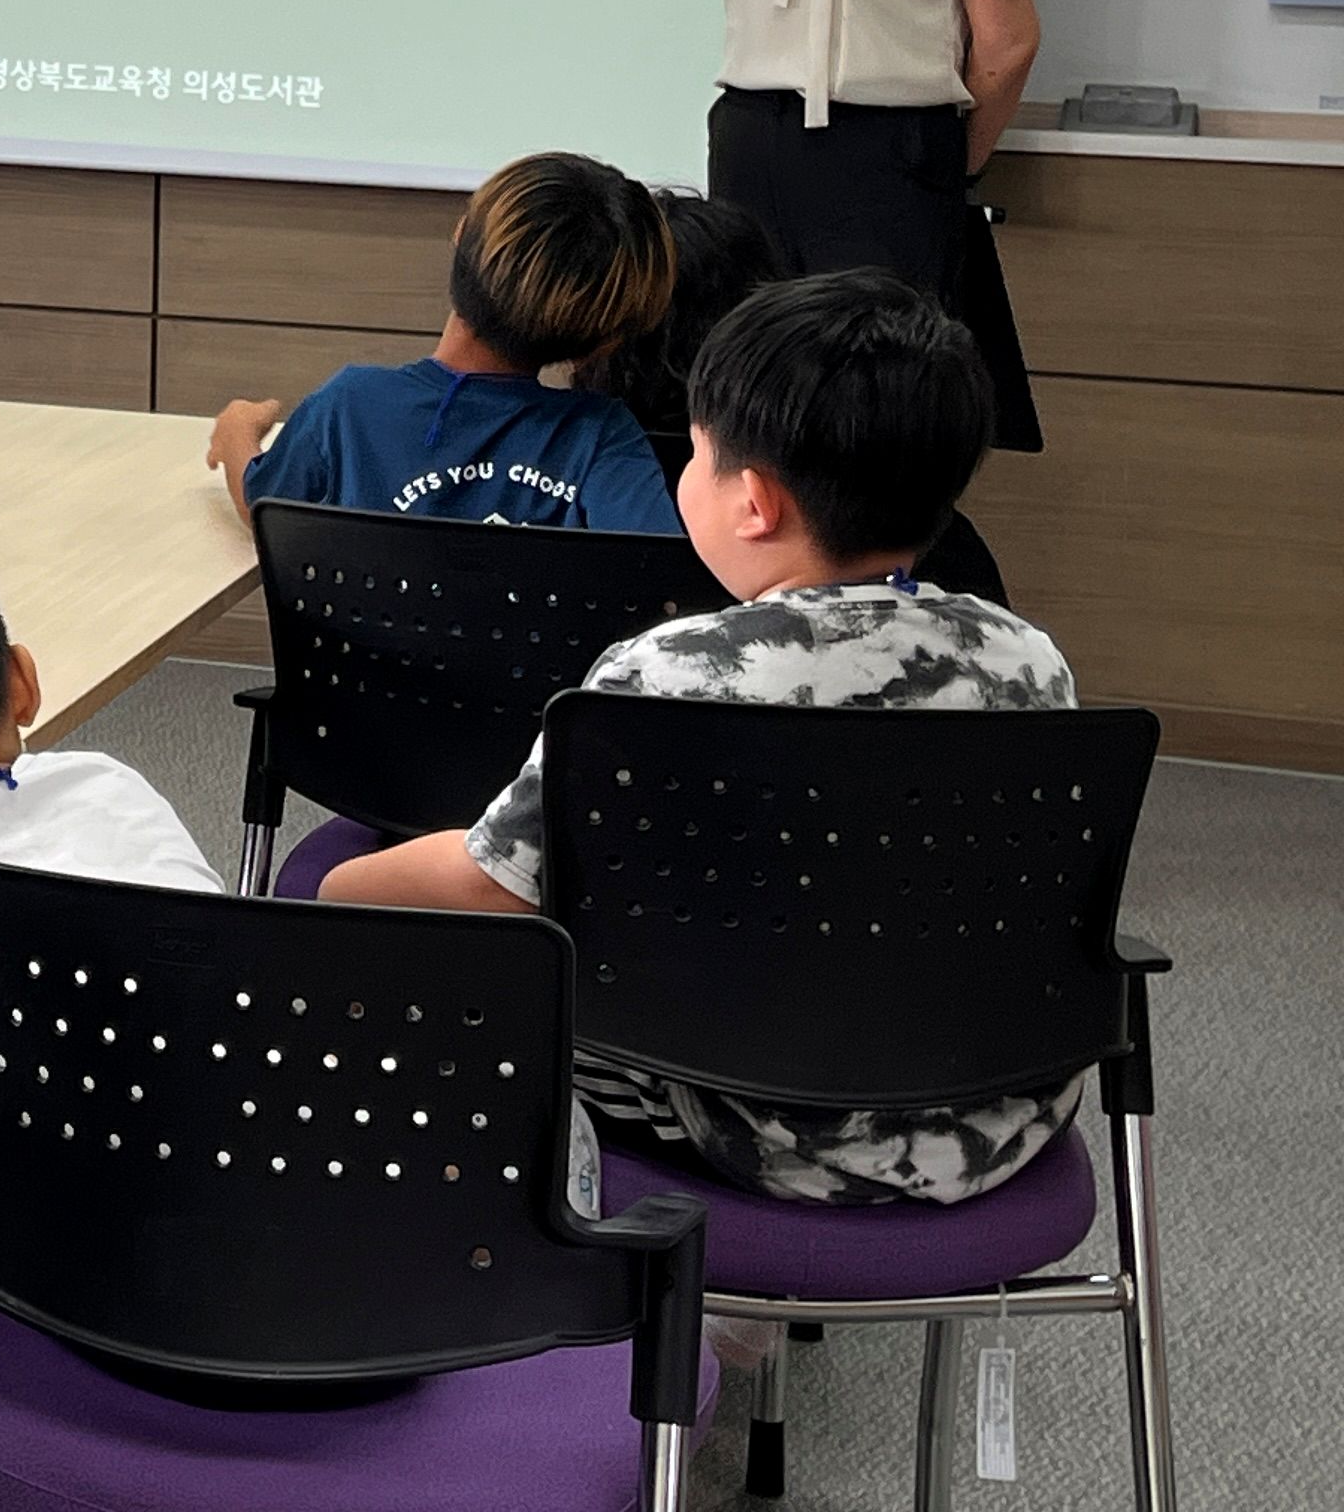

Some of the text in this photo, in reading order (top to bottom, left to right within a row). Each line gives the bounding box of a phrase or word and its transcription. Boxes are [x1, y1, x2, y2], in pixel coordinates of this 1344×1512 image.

[181, 69, 325, 109] 의성도서관
[392, 471, 443, 512] LETS
[447, 461, 495, 485] YOU
